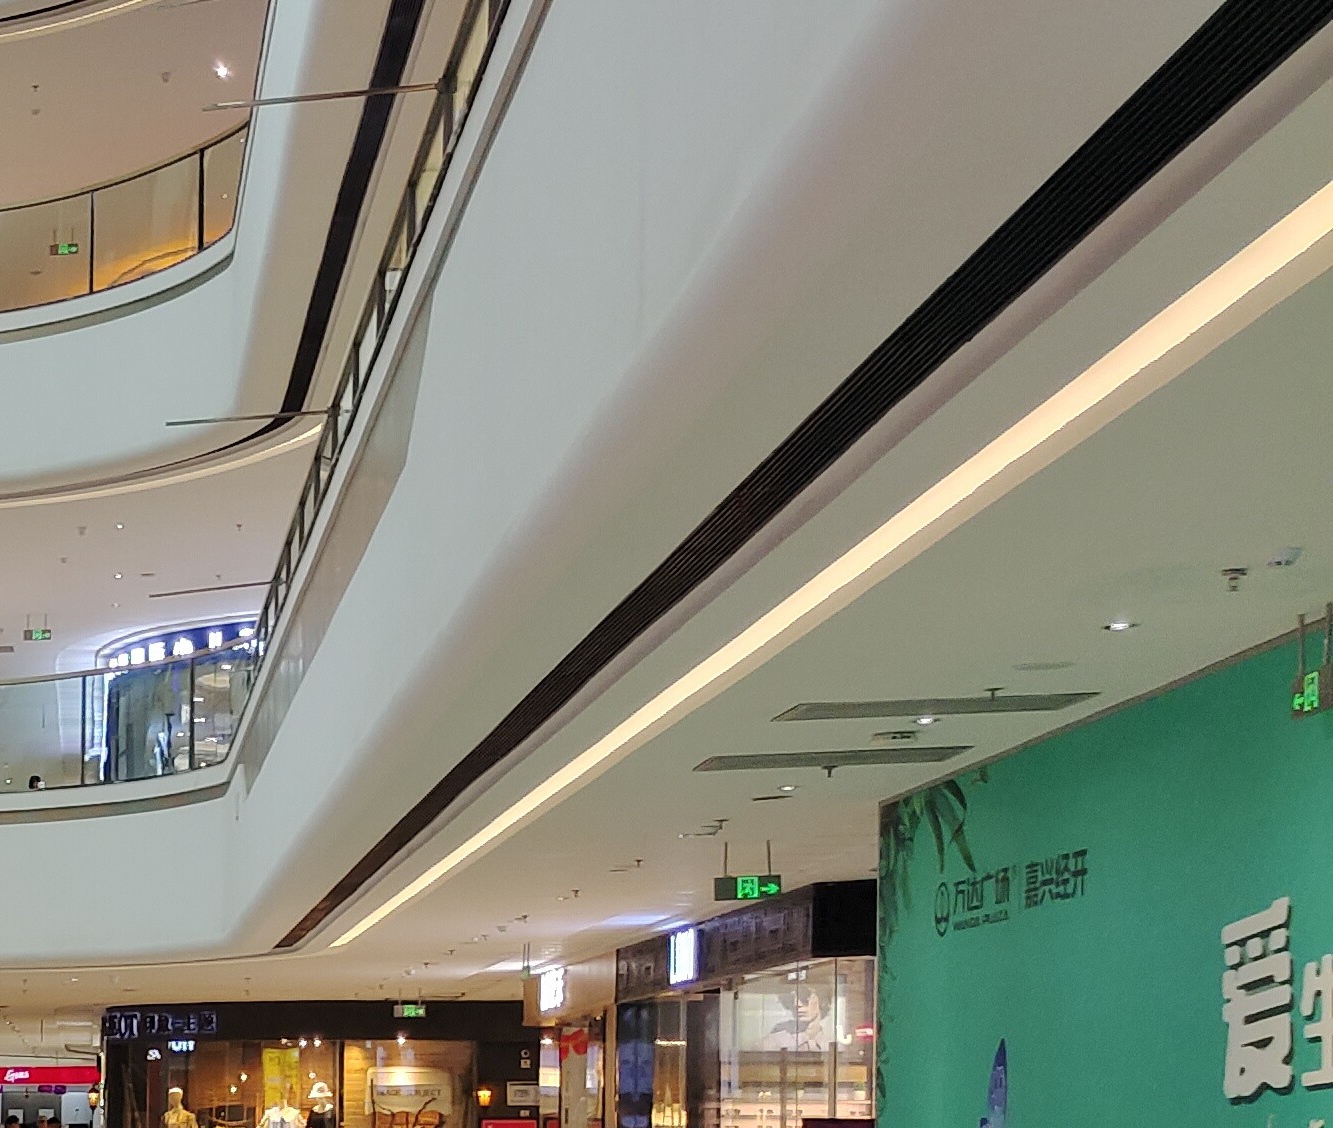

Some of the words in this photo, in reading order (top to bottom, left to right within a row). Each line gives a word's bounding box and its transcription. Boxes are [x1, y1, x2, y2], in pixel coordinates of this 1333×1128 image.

[953, 867, 1010, 916] 万达广场
[1024, 848, 1089, 910] 嘉兴经开
